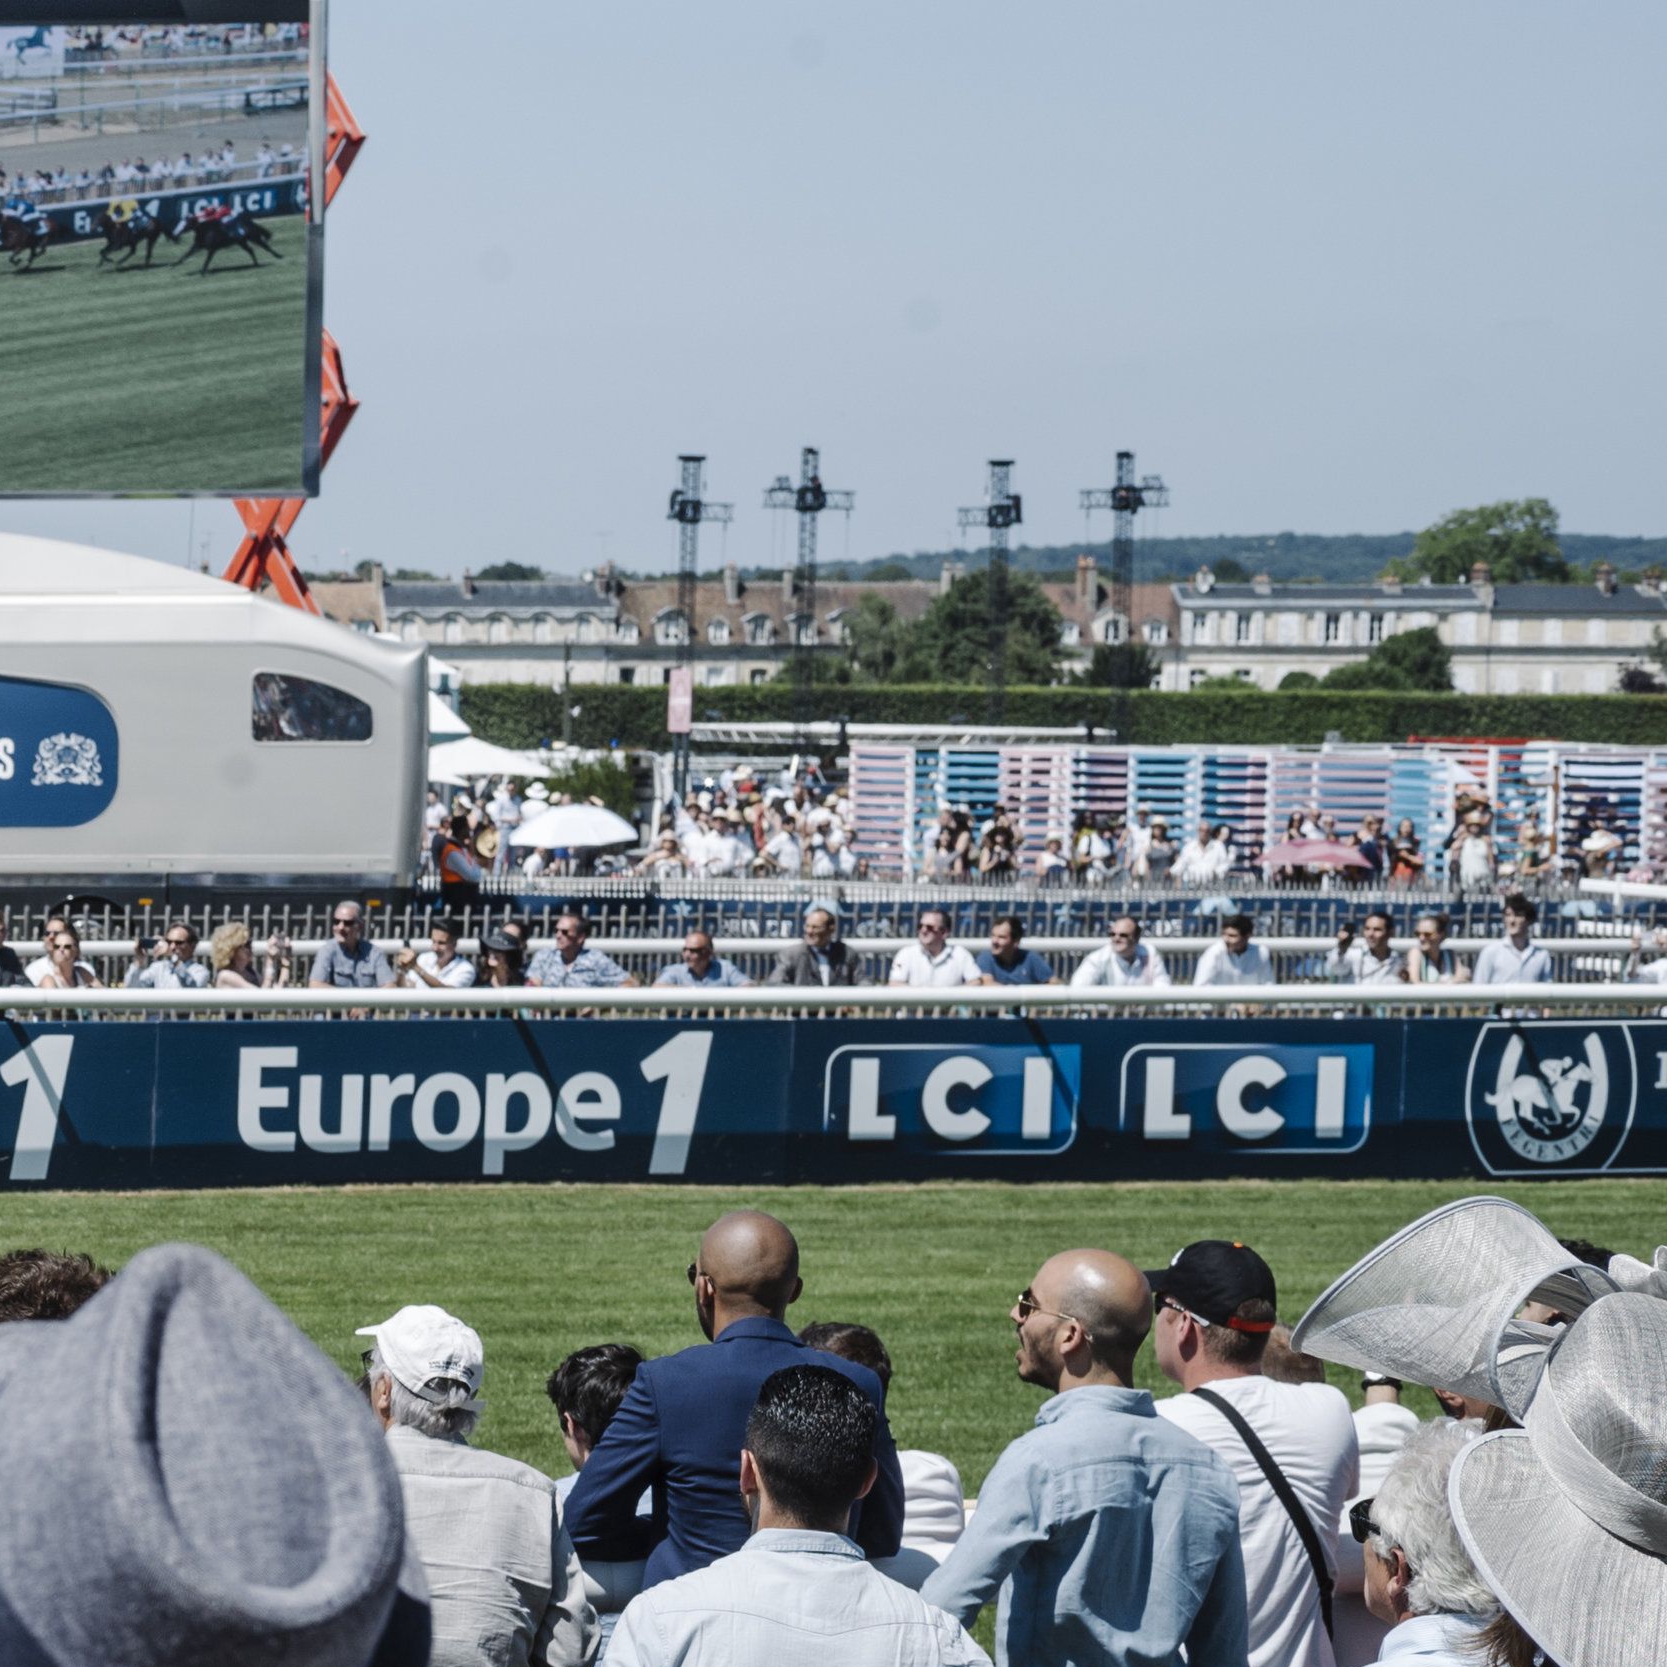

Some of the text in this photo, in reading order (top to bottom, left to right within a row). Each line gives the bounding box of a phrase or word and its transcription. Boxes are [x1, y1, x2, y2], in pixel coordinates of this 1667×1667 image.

[236, 1030, 714, 1176] Europe 1
[848, 1055, 1054, 1142] LCI
[1143, 1055, 1347, 1140] LCI
